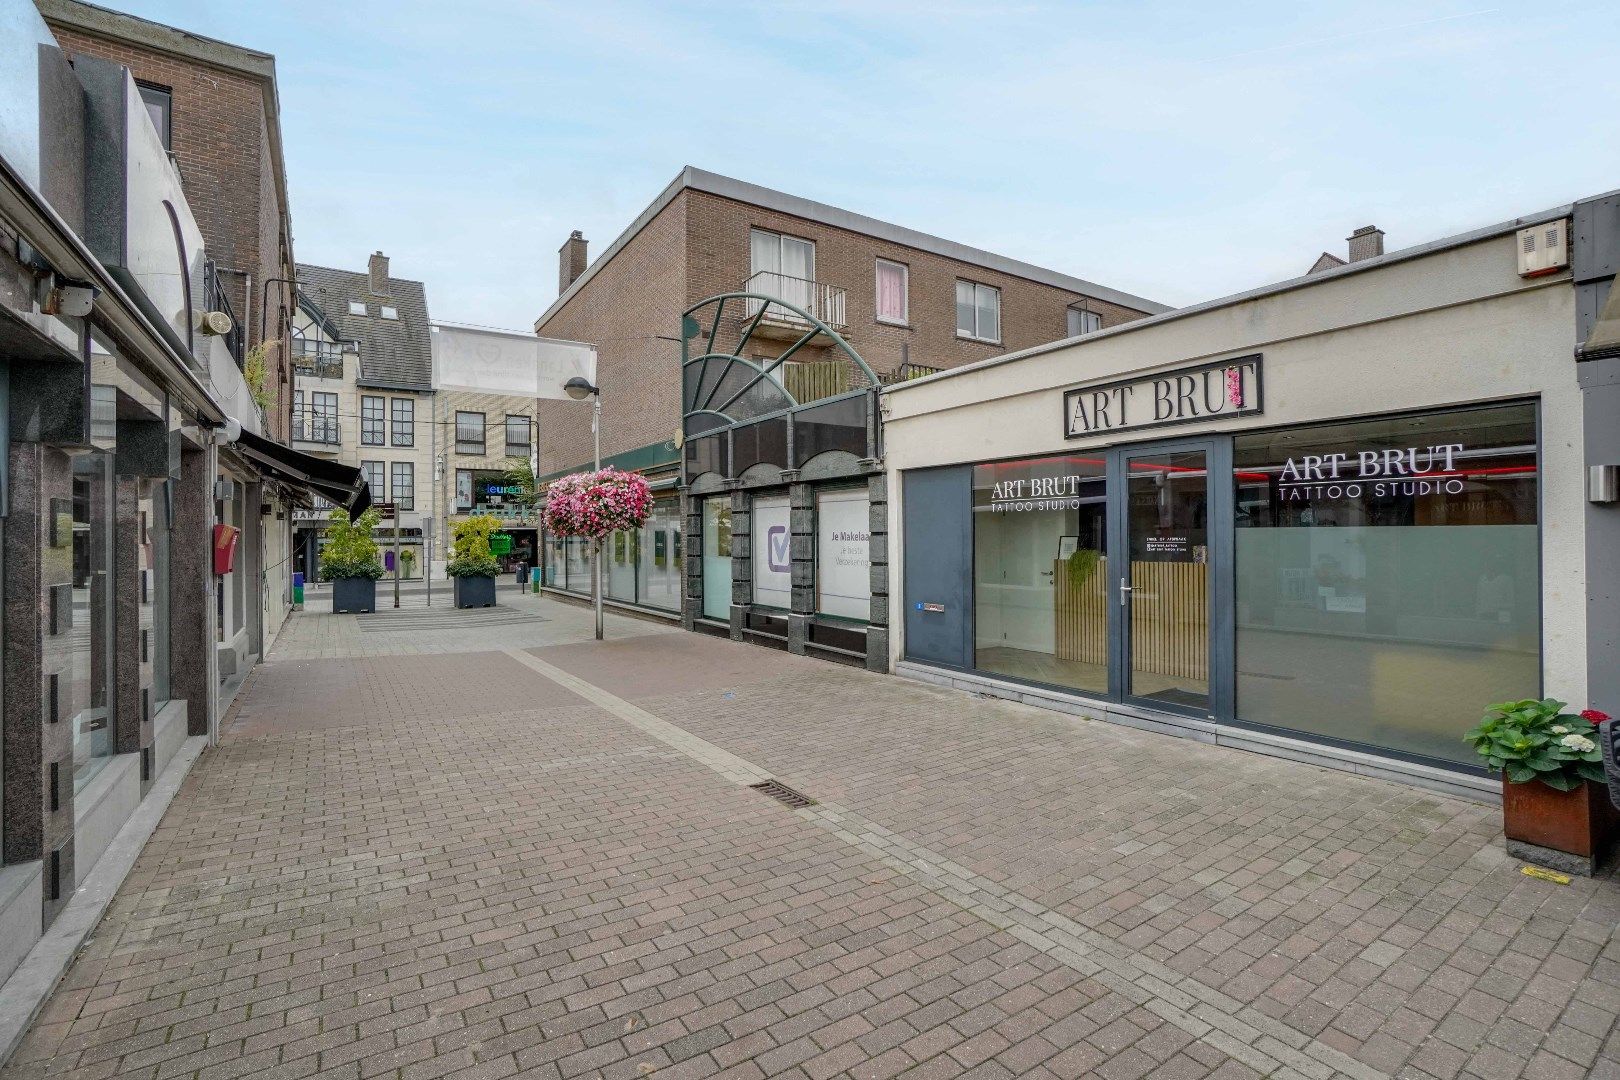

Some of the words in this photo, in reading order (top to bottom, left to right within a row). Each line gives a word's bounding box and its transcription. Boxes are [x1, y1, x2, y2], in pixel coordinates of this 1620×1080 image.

[1071, 386, 1133, 433] ART
[1153, 363, 1254, 420] BRUT
[1279, 453, 1346, 482] ART
[1358, 443, 1463, 477] BRUT
[991, 479, 1025, 499] ART
[1030, 475, 1080, 497] BRUT
[1279, 484, 1361, 501] TATTOO
[1375, 479, 1463, 497] STUDIO
[991, 501, 1033, 513] TATTOO
[1038, 499, 1080, 511] STUDIO
[831, 531, 839, 541] Je
